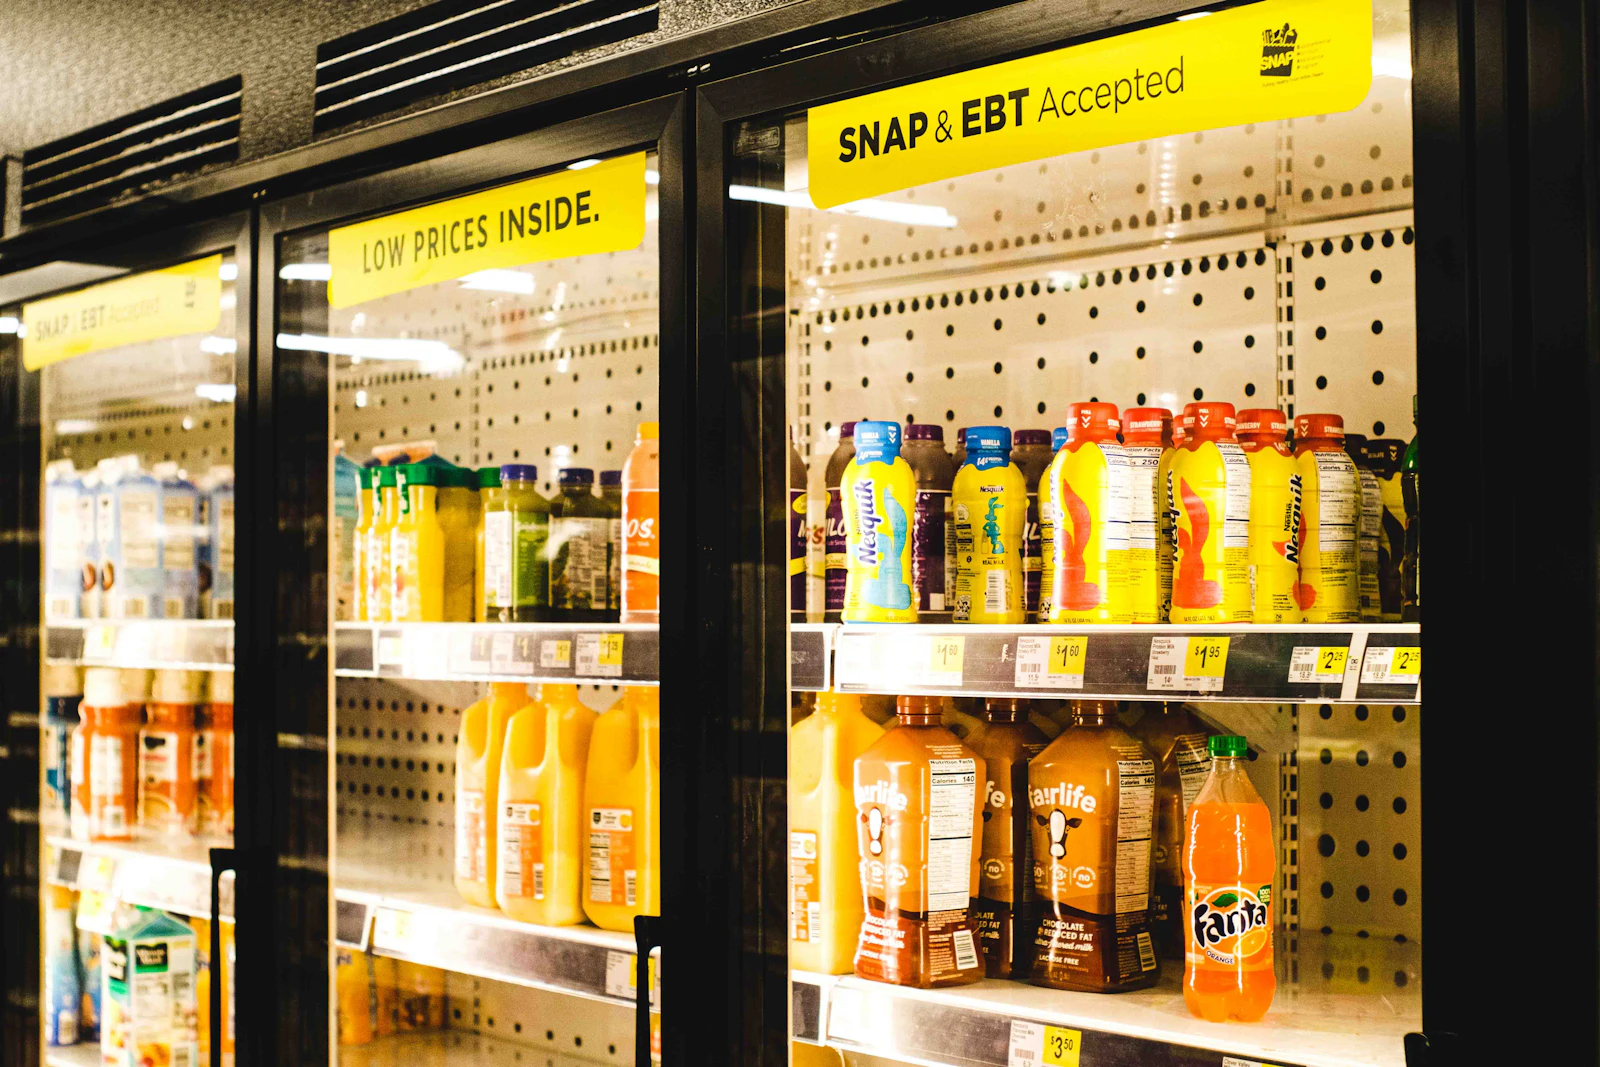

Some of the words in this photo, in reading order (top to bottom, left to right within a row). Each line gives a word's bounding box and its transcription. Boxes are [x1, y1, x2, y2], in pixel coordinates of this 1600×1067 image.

[1260, 51, 1294, 70] SNAP
[839, 111, 928, 162] SNAP
[934, 110, 953, 142] &
[962, 87, 1029, 138] EBT
[1038, 55, 1184, 122] Accepted
[364, 234, 403, 274] LOW
[414, 214, 488, 262] PRICES
[499, 190, 600, 242] INSIDE.
[36, 318, 69, 342] SNAP
[81, 304, 106, 331] EBT
[980, 486, 1004, 494] Nesquik
[855, 481, 882, 564] Nesquik
[1194, 899, 1266, 948] Fanta
[1079, 933, 1093, 941] FAT
[1075, 942, 1093, 952] milk
[1039, 955, 1062, 963] LACOSE
[1064, 958, 1079, 966] FREE
[1206, 950, 1234, 964] ORANGE
